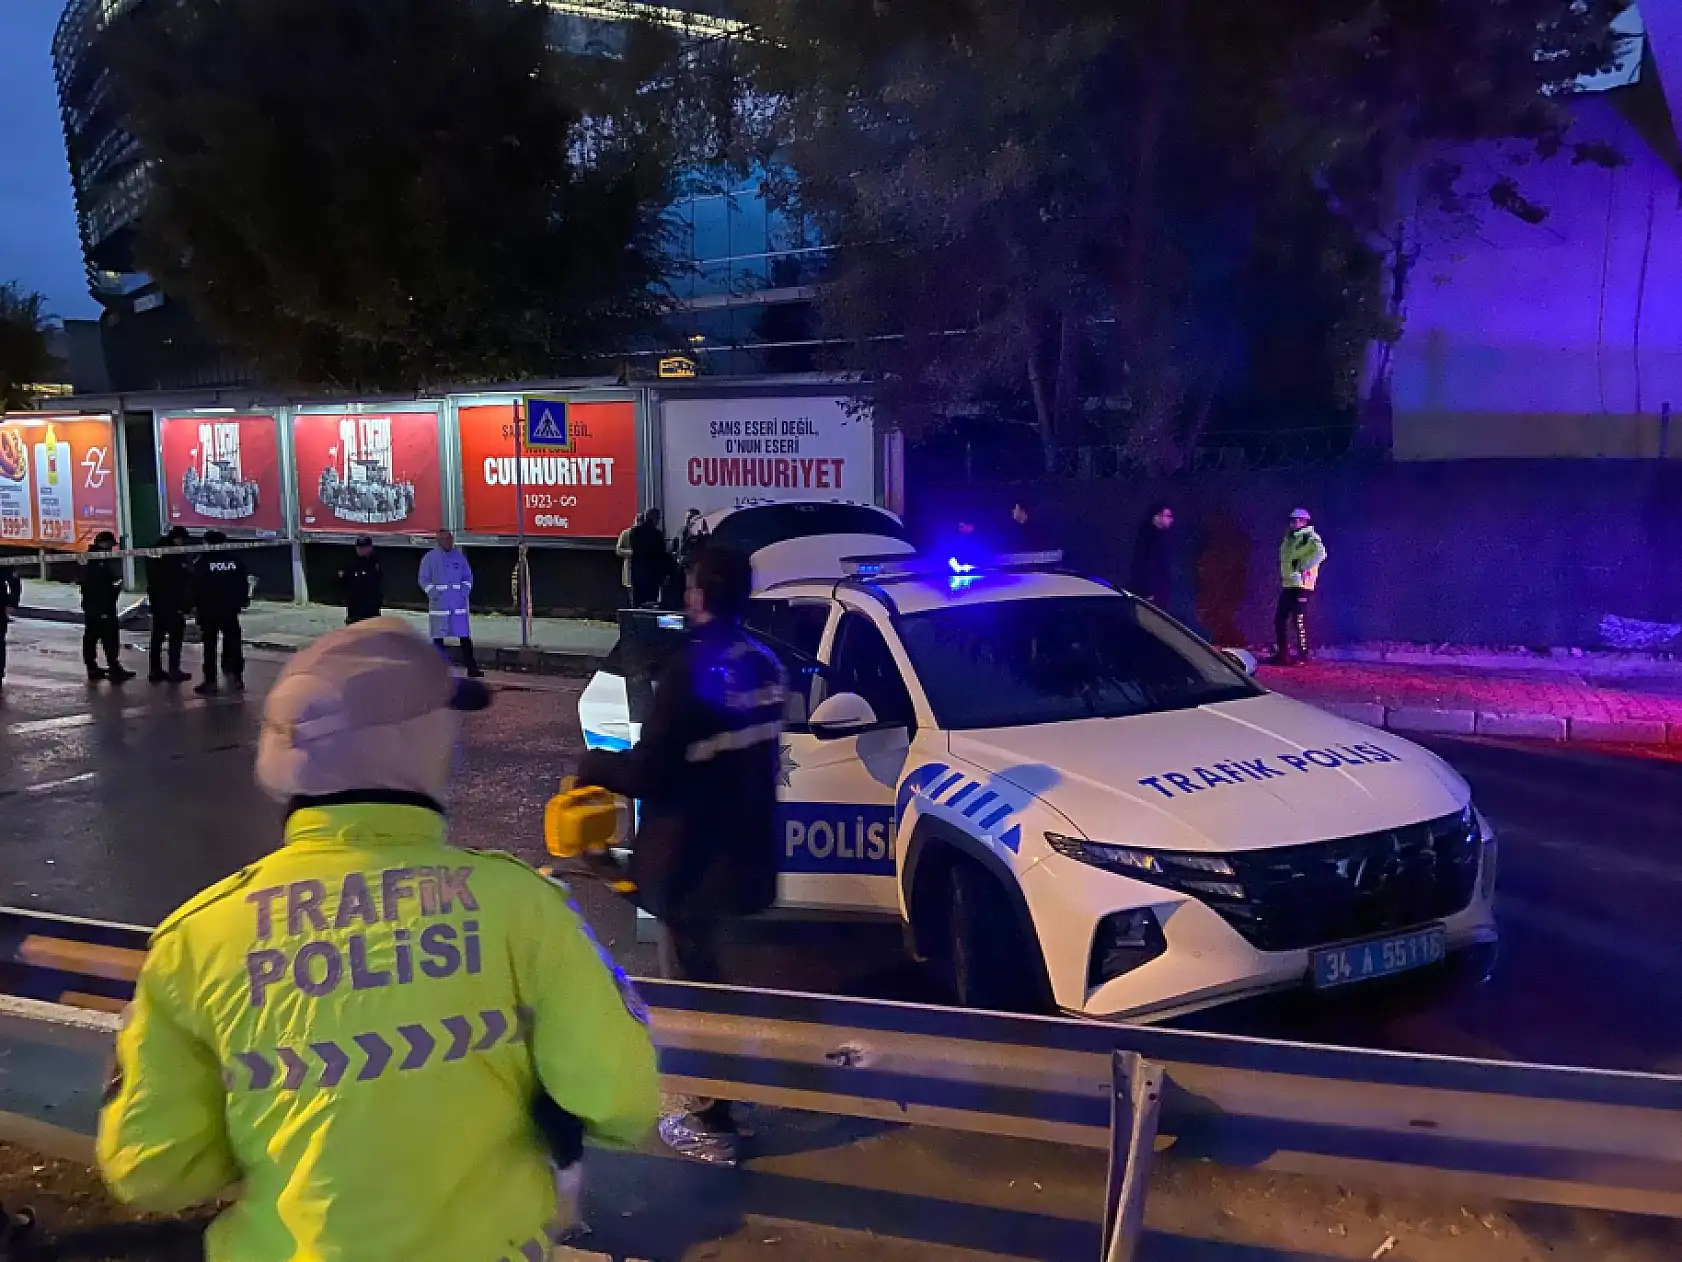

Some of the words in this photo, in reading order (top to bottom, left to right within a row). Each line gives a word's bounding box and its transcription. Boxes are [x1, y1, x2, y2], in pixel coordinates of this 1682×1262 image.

[709, 420, 741, 438] ŞANS
[745, 417, 778, 436] ESERİ
[782, 417, 819, 437] DEĞİL,
[726, 439, 761, 454] O'NUN
[765, 436, 800, 454] ESERİ
[1138, 758, 1286, 798] TRAFİK
[1276, 741, 1402, 773] POLİSİ
[785, 815, 896, 860] POLİSİ
[1327, 952, 1352, 981] 34
[1362, 946, 1374, 974] A
